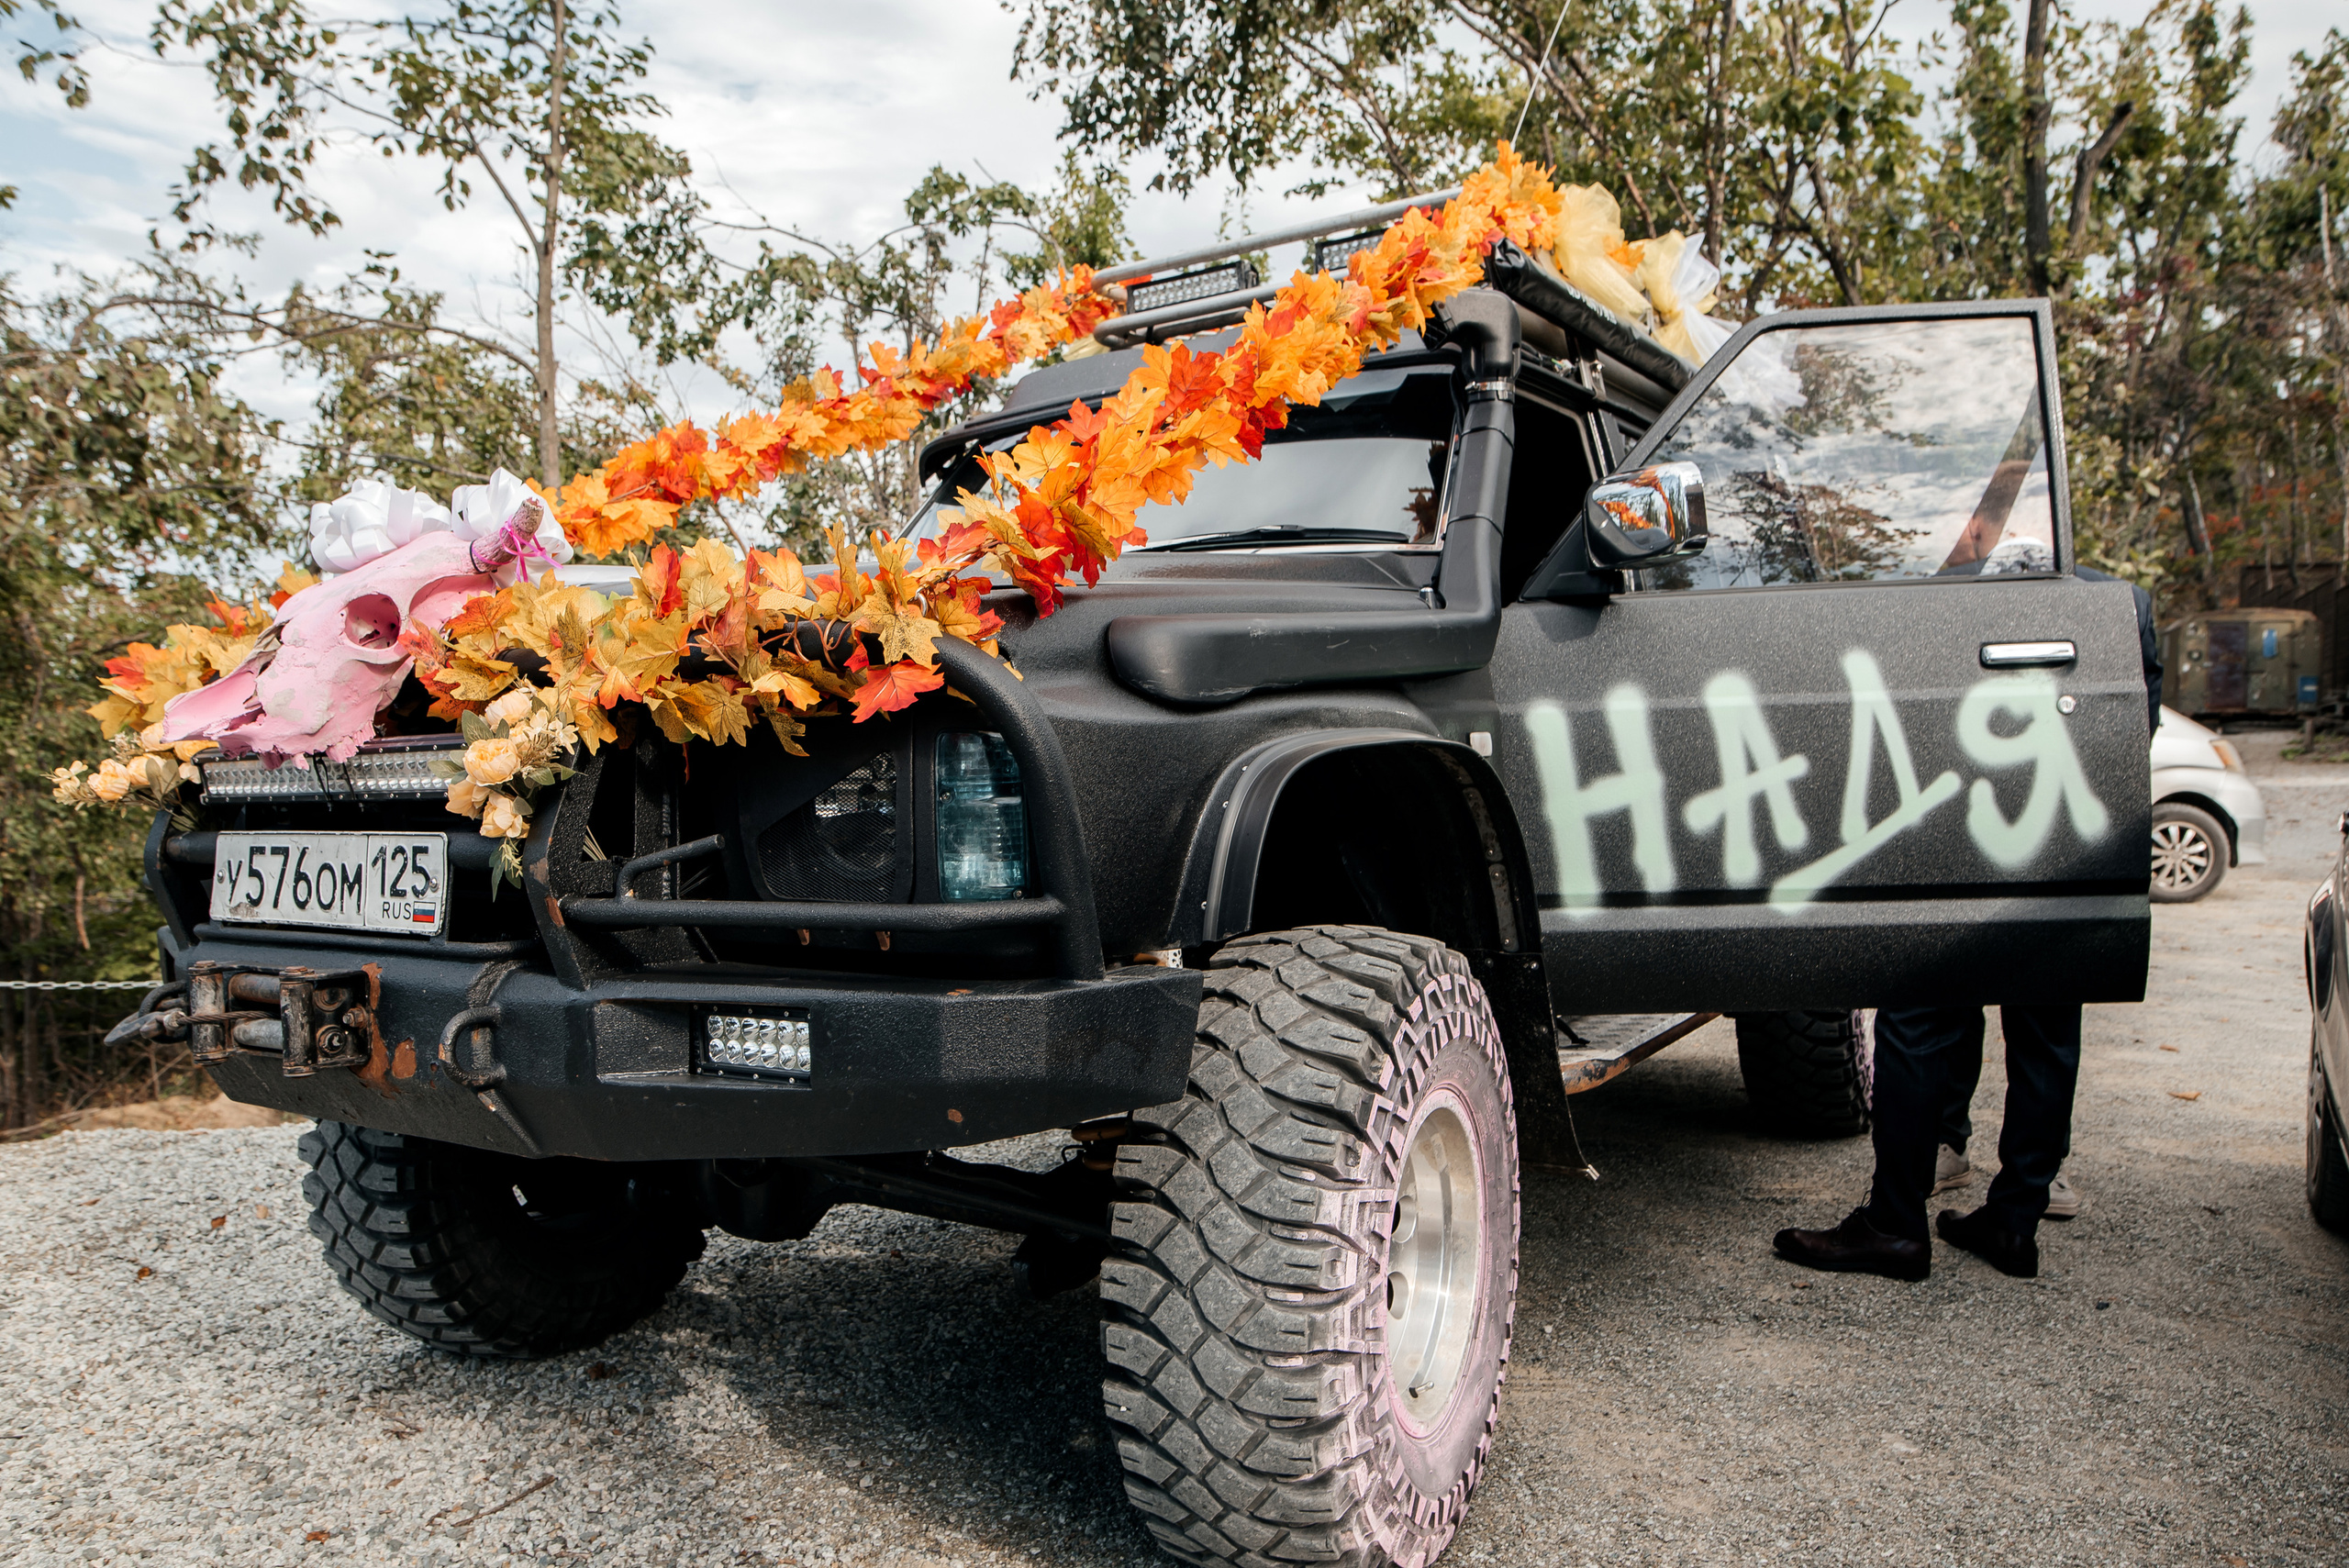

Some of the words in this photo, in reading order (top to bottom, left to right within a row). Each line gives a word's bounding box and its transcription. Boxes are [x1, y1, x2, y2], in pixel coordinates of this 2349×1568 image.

[1524, 647, 2110, 917] НАДЯ
[372, 845, 431, 898] 125
[382, 901, 412, 920] RUS
